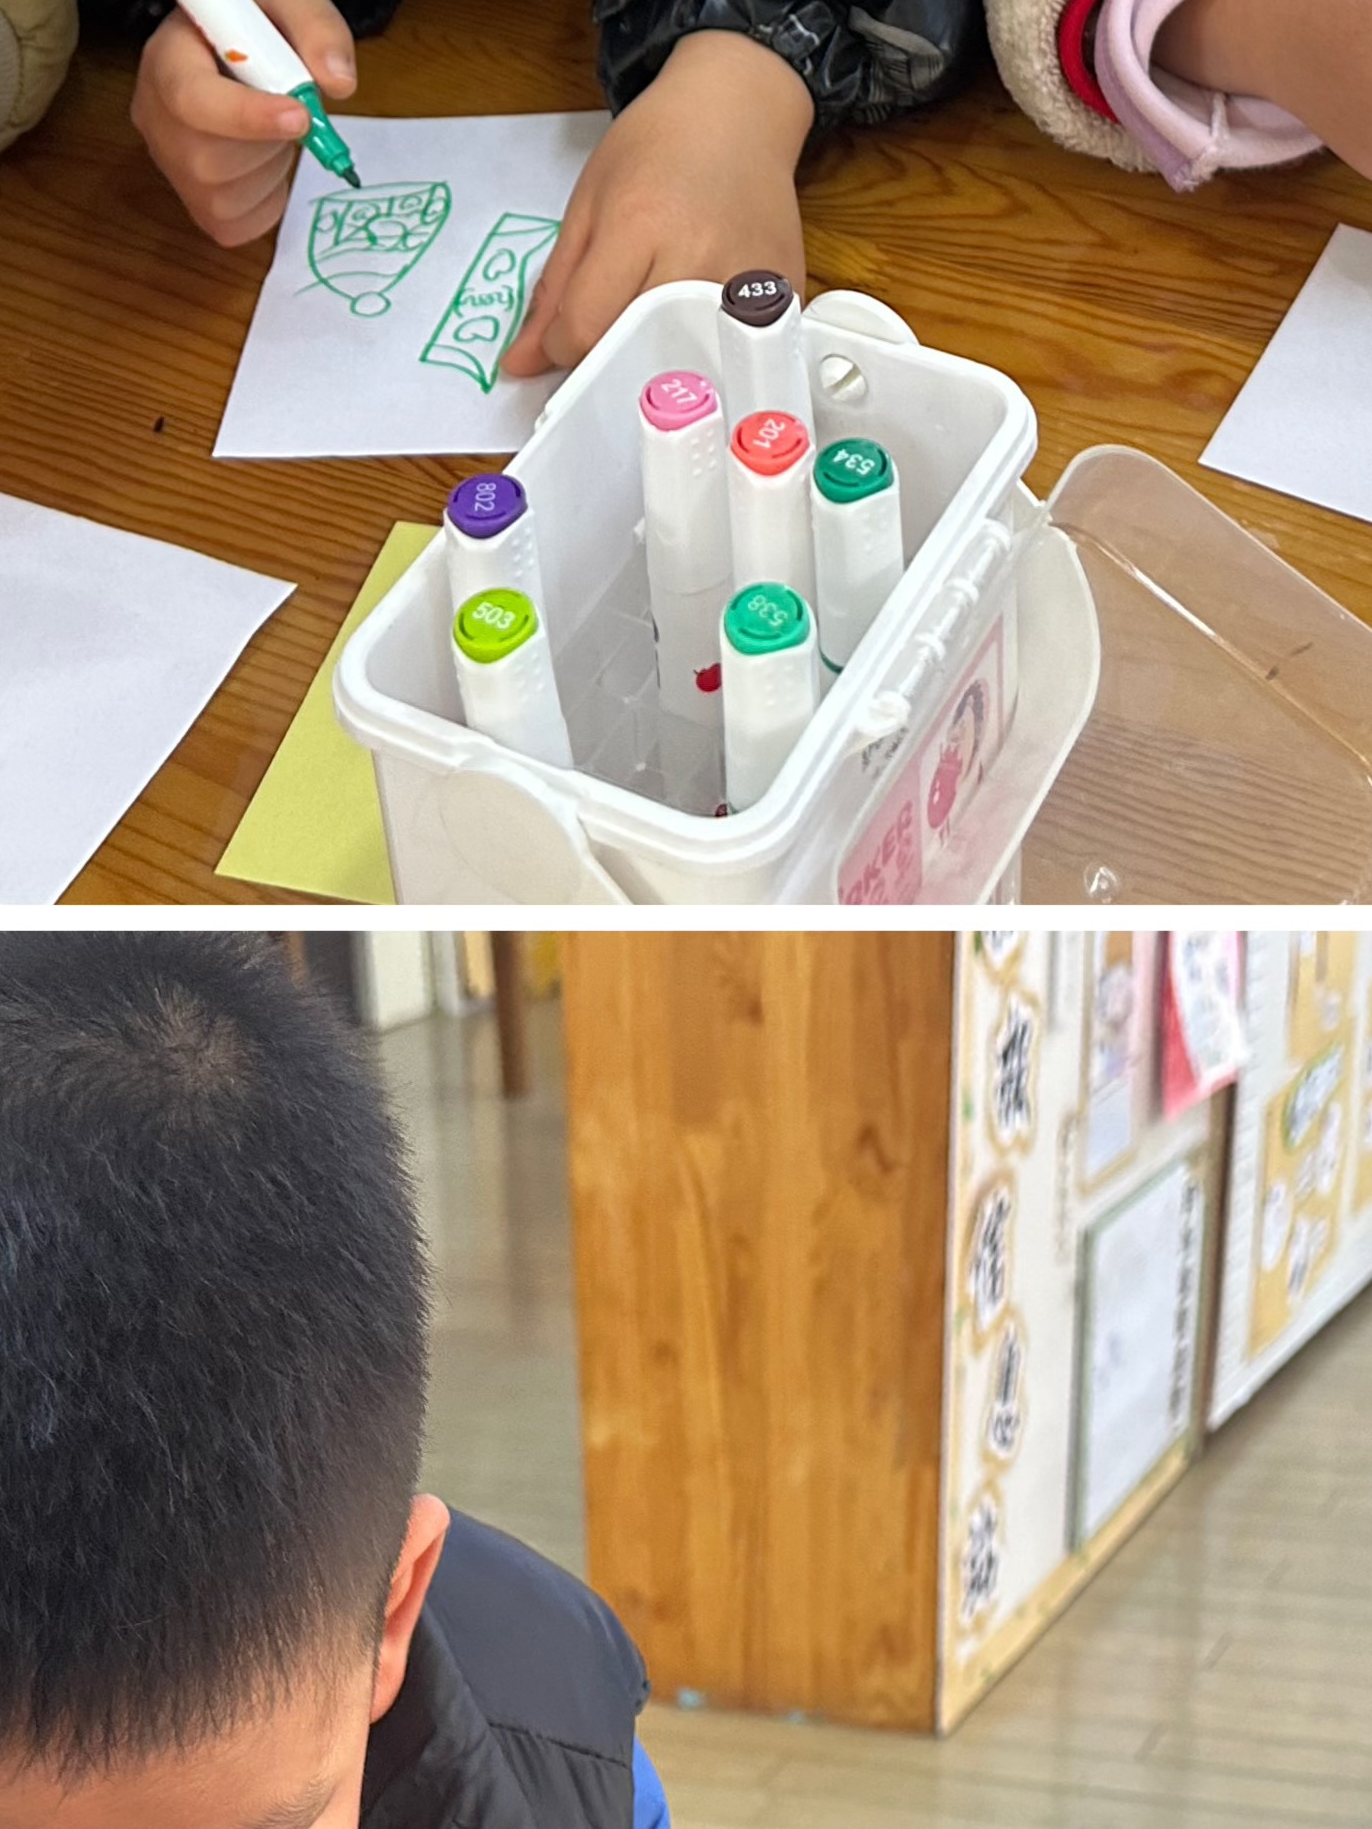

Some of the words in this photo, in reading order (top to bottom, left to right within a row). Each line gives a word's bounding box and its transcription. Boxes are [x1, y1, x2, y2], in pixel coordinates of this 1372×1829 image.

[738, 280, 777, 298] 433
[661, 378, 698, 404] 217
[752, 418, 786, 449] 201
[833, 449, 876, 476] 534
[474, 482, 497, 512] 802
[472, 601, 516, 630] 503
[747, 595, 788, 627] 538
